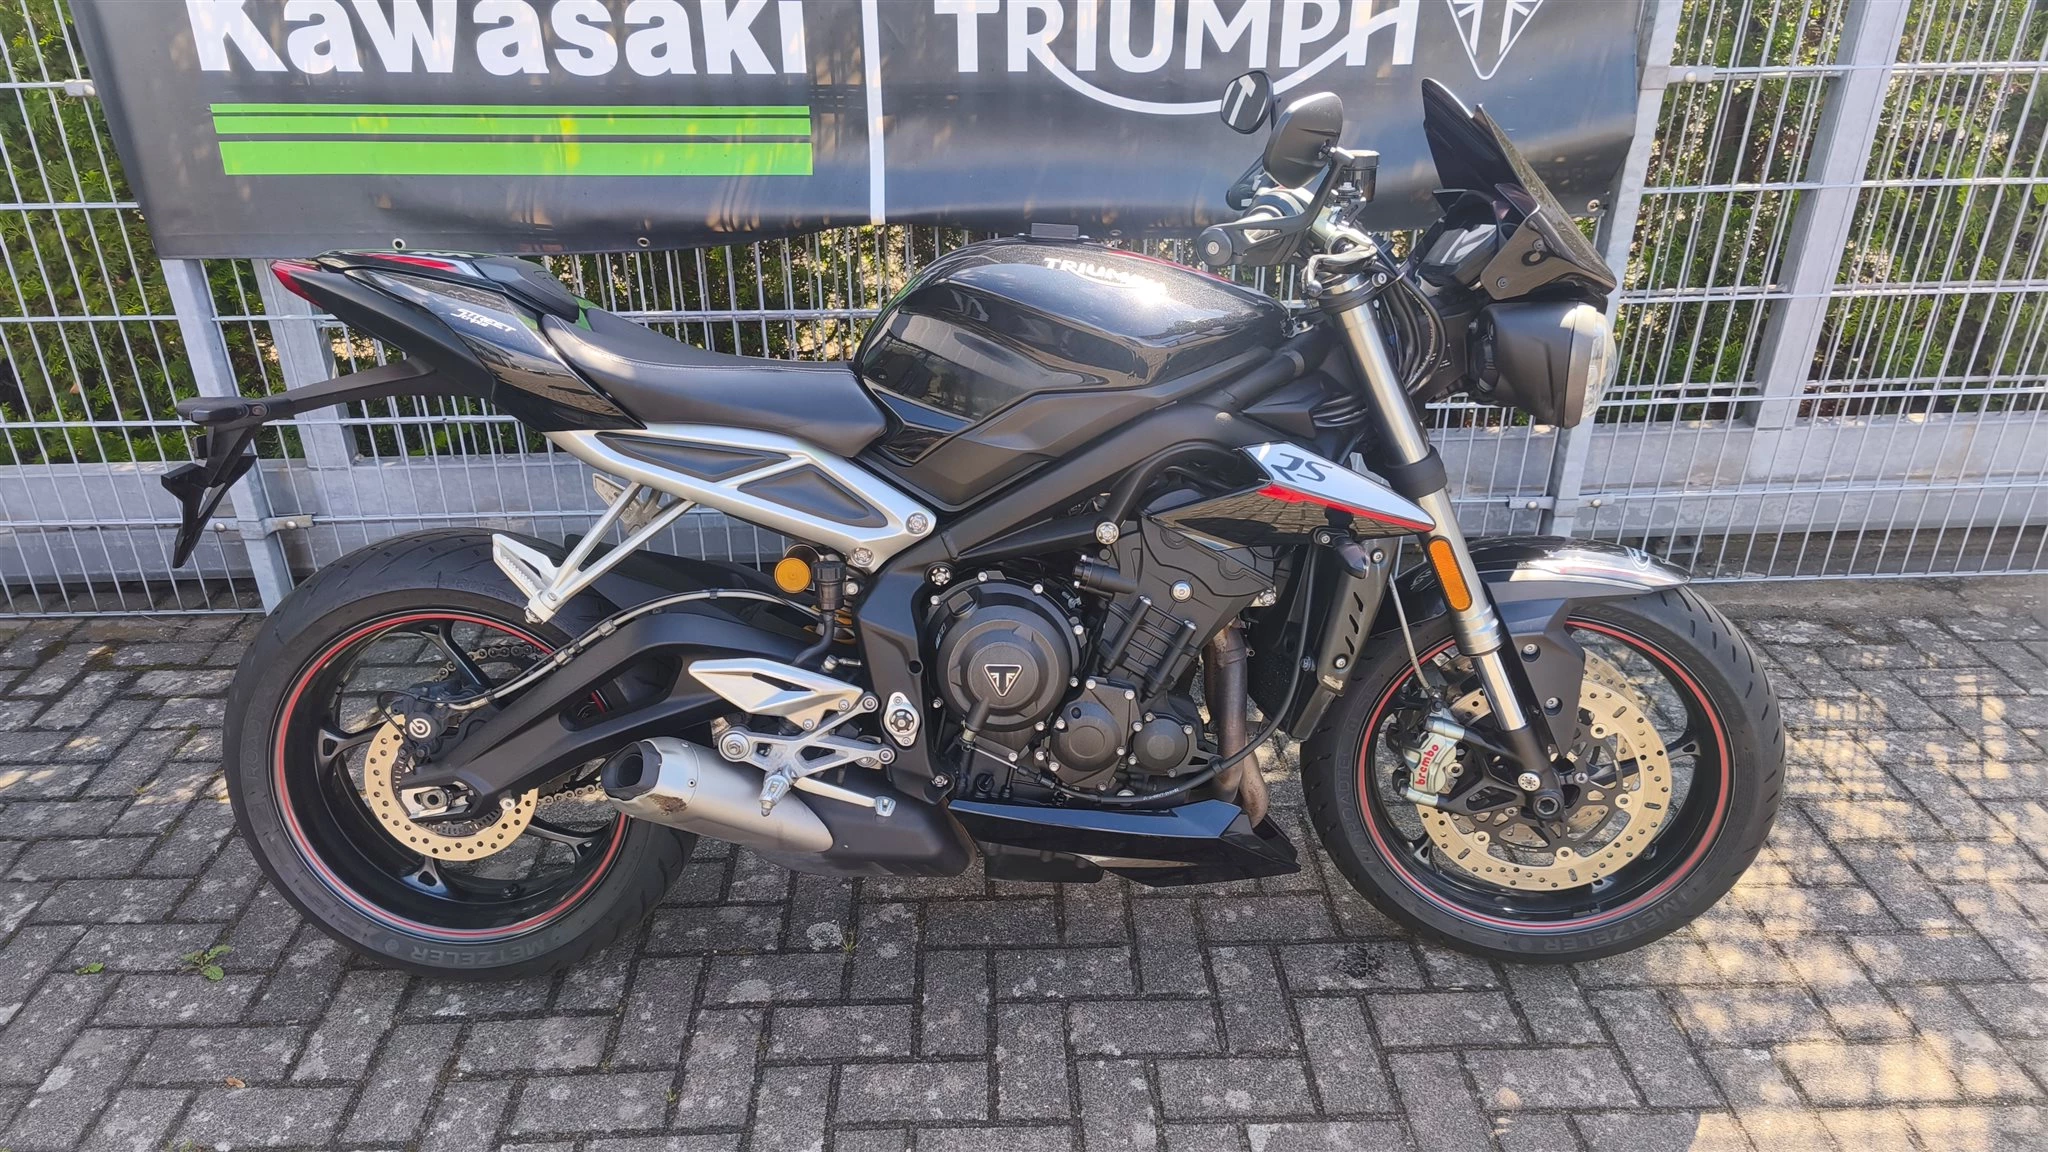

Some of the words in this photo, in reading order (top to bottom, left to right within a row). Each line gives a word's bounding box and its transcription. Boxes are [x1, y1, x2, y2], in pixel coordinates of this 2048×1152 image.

[185, 0, 807, 76] Kawasaki
[932, 0, 1419, 115] TRIUMPH
[1271, 453, 1333, 482] RS
[1415, 744, 1439, 786] brembo
[1543, 897, 1678, 951] METZELER
[410, 939, 546, 966] METZELER
